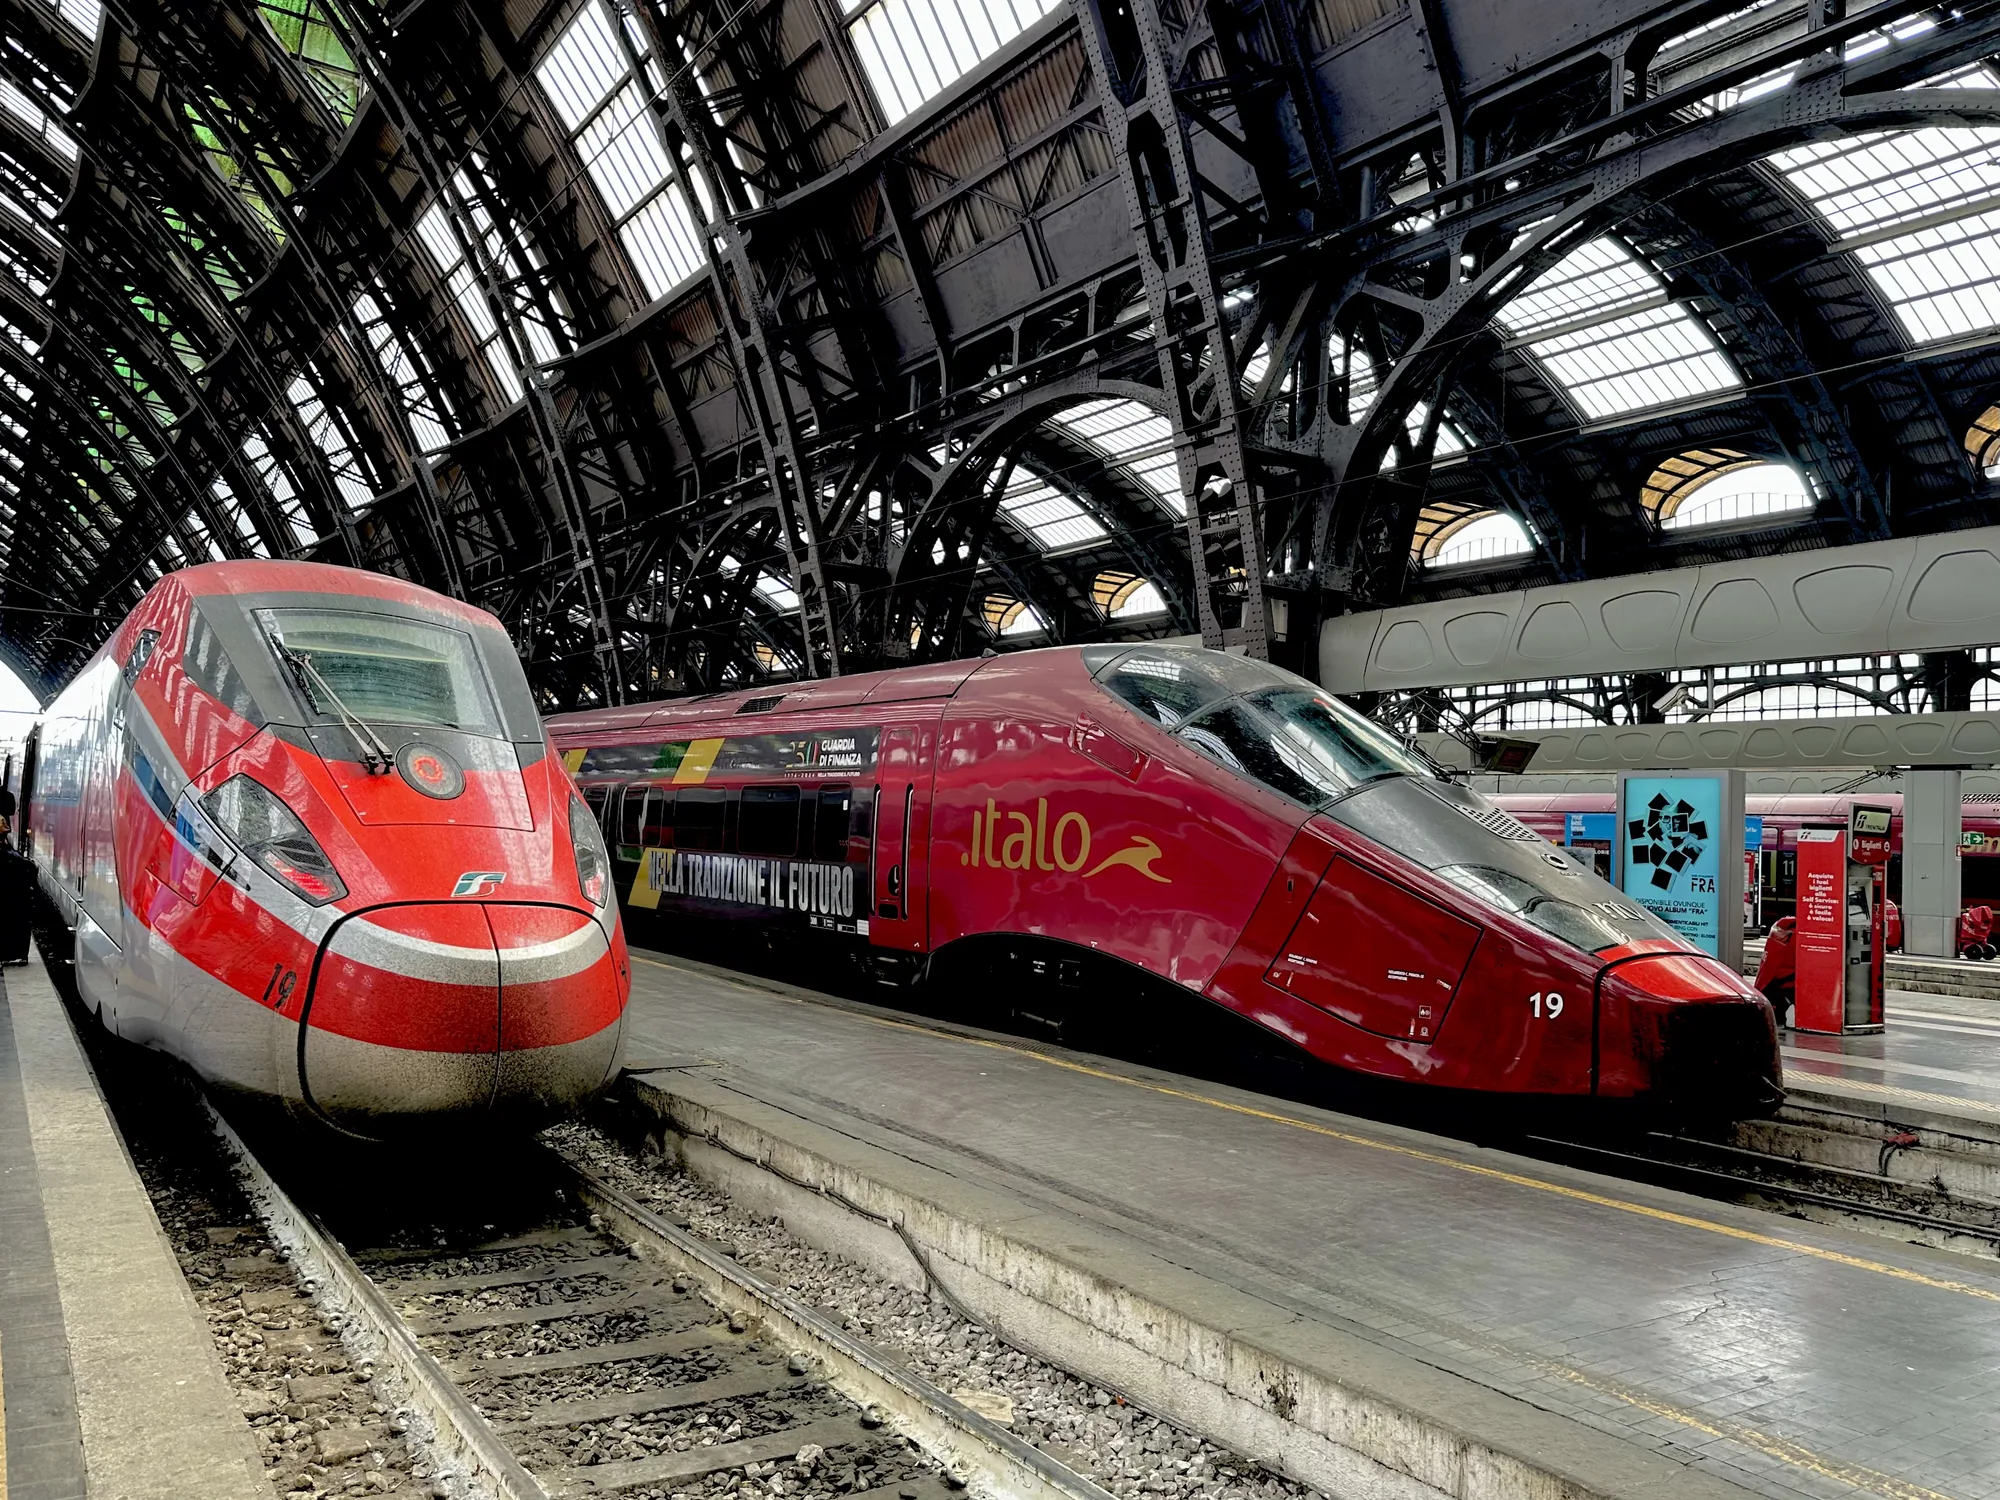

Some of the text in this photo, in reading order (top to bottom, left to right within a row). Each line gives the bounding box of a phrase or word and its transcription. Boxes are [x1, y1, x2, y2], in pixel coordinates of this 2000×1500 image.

[821, 738, 855, 751] GUARDIA
[819, 753, 862, 767] DI FINANZA
[1861, 840, 1882, 851] Biglietti
[1783, 859, 1794, 876] 11
[1808, 872, 1834, 880] Acquista
[649, 850, 854, 918] NELLA TRADIZIONE IL FUTURO
[1691, 878, 1715, 893] FRA
[1635, 898, 1706, 909] DISPONIBILE OVUNQUE
[263, 963, 297, 1008] 19
[1530, 992, 1564, 1020] 19
